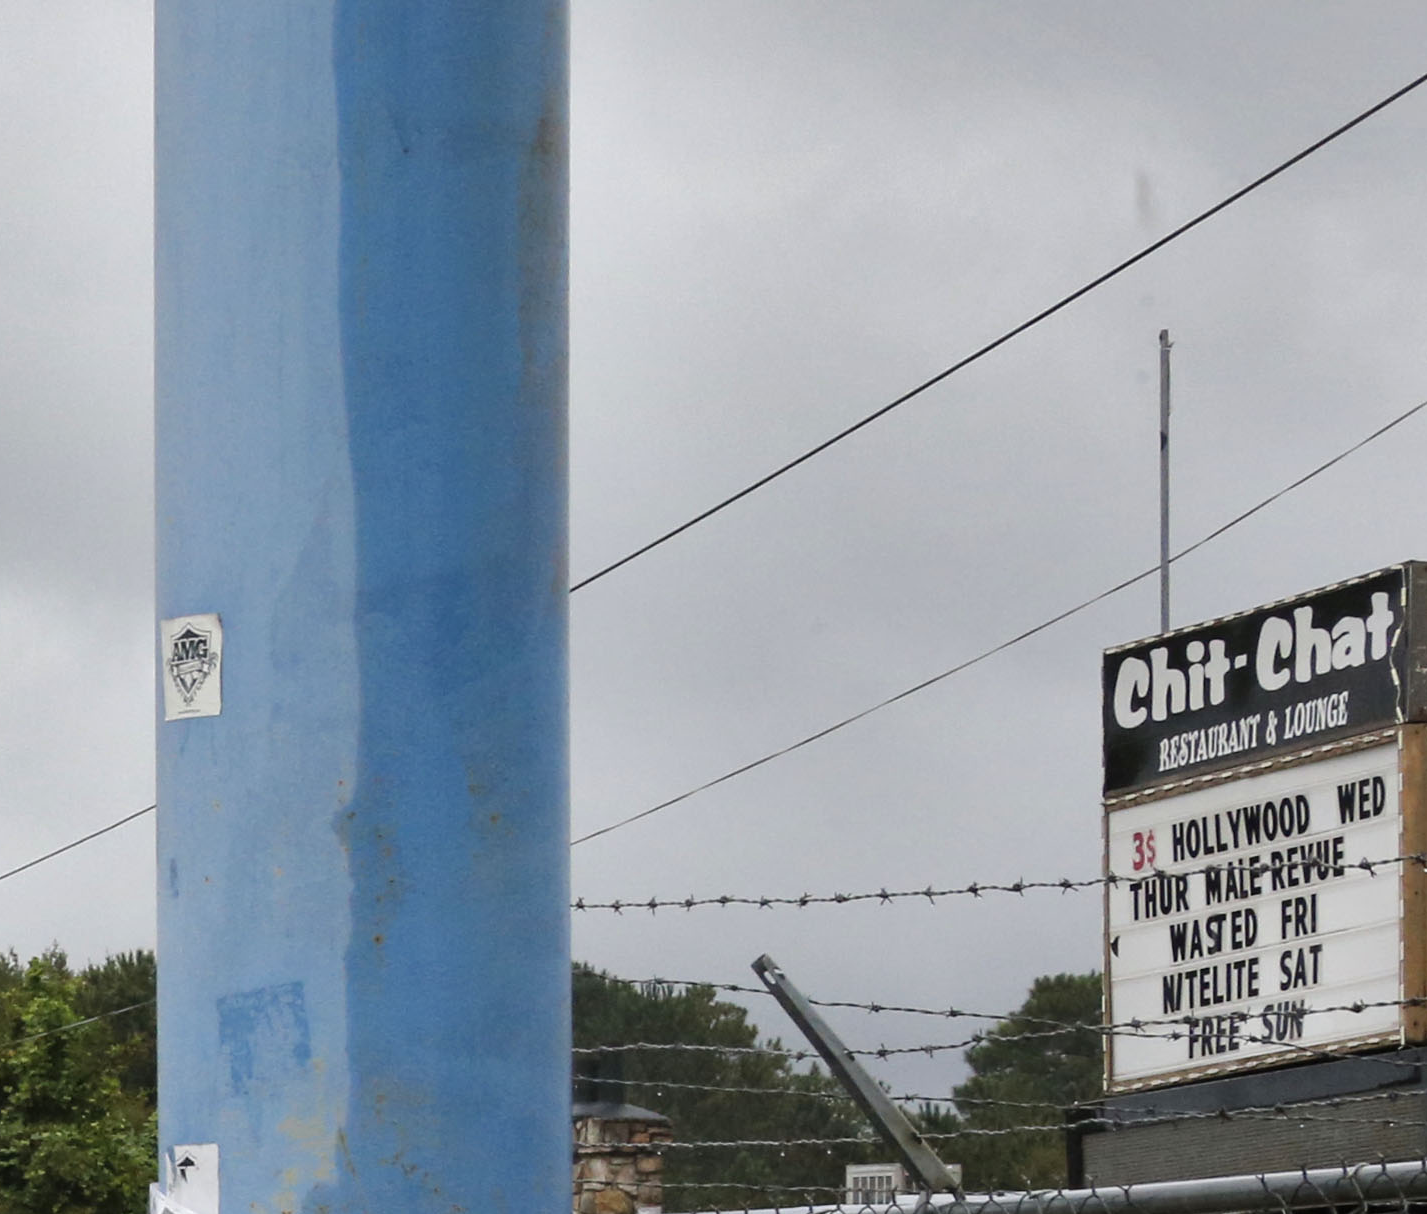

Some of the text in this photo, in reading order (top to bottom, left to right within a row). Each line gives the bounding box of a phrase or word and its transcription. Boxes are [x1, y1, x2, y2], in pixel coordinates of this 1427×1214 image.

[1113, 591, 1394, 729] Chit-Chat
[1158, 690, 1349, 772] RESTAURANT & LOUNGE
[1171, 794, 1310, 862] HOLLYWOOD
[1336, 775, 1386, 825] WED
[1129, 836, 1345, 921] THUR MALE REVUE
[1169, 893, 1317, 963] WASTED FRI
[1162, 944, 1323, 1015] NITELITE SAT
[1188, 998, 1305, 1060] FREE SUN
